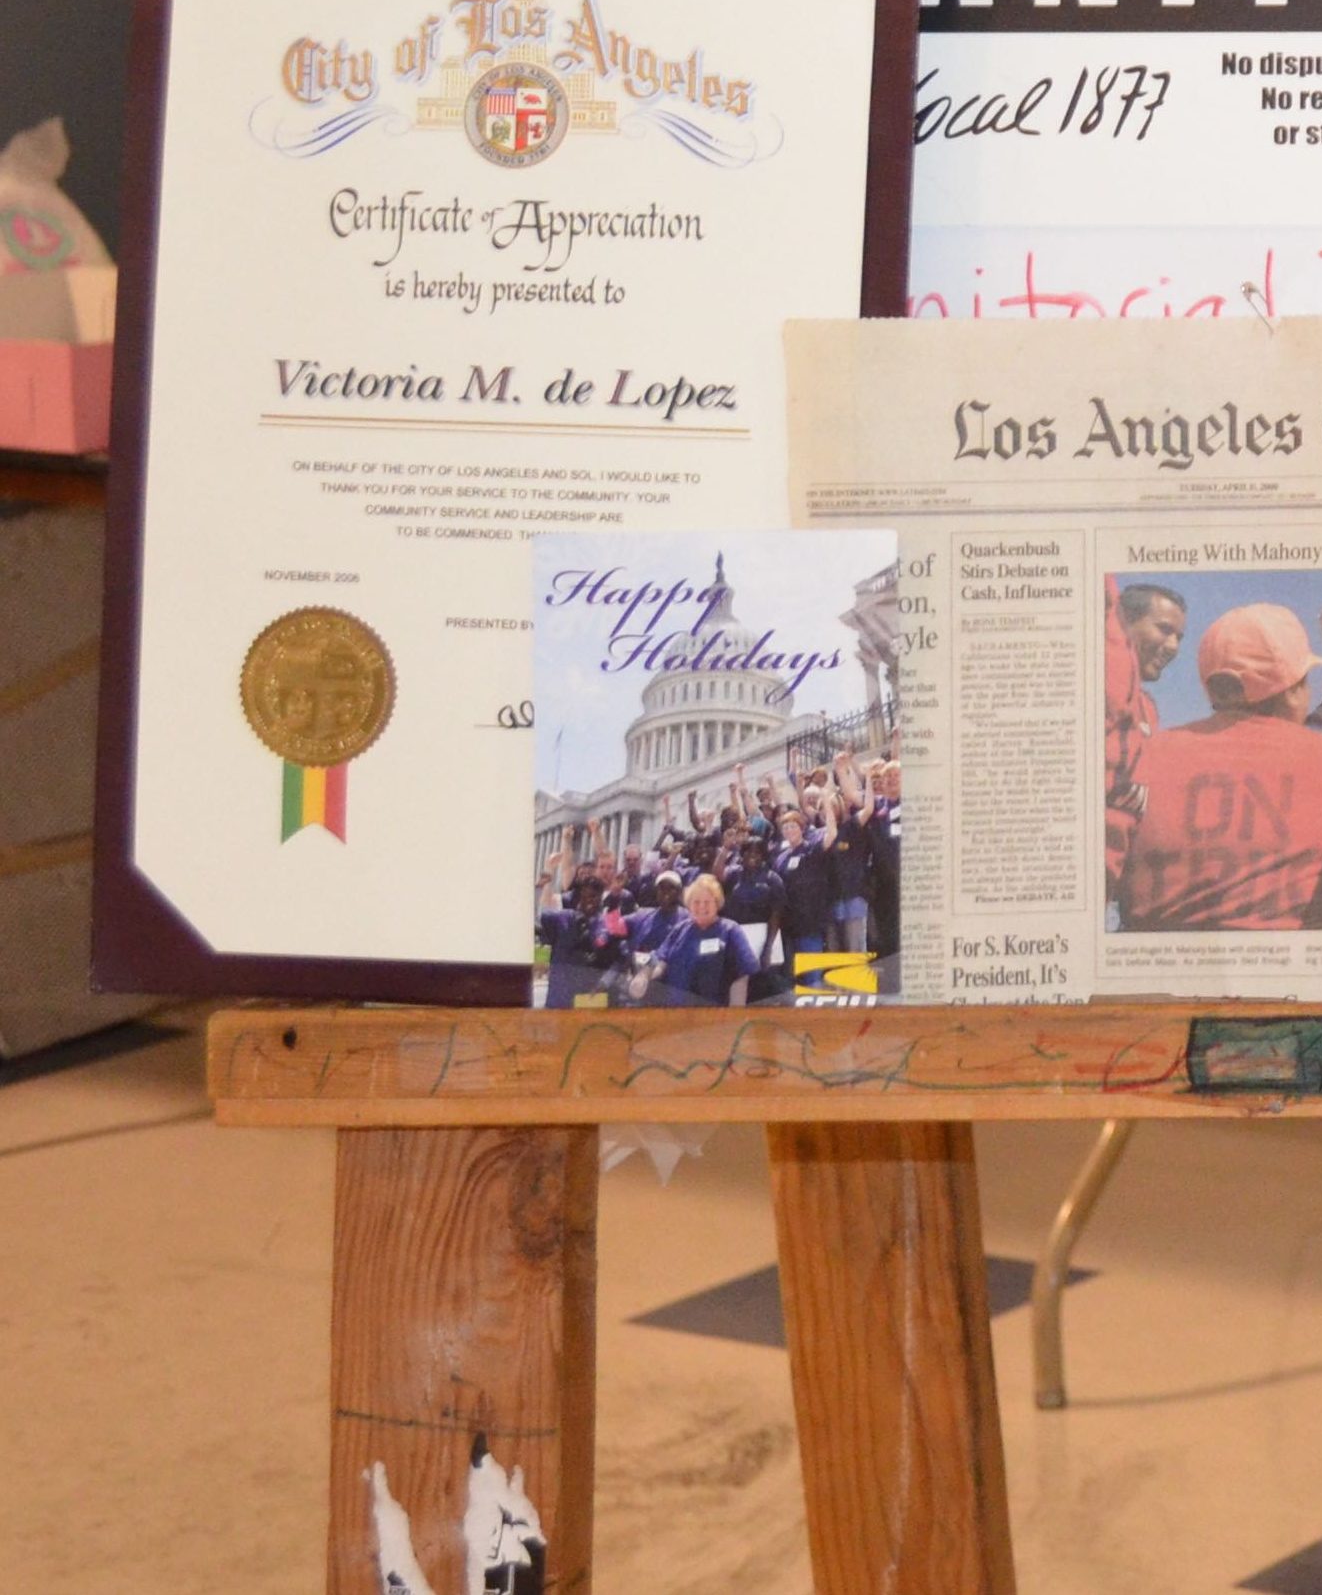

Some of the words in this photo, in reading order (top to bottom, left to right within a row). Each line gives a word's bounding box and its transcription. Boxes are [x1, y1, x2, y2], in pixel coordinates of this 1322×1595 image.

[281, 34, 376, 105] City
[392, 13, 440, 82] of
[1221, 52, 1253, 76] No
[914, 69, 1056, 145] ocal
[1261, 87, 1292, 110] No
[1273, 125, 1299, 145] or
[329, 187, 473, 267] Certificate
[481, 206, 505, 233] of
[491, 199, 705, 273] Appreciation
[385, 271, 405, 298] is
[413, 269, 481, 315] hereby
[490, 271, 596, 315] presented
[604, 277, 626, 304] to
[273, 359, 445, 401] Victoria
[458, 365, 522, 404] M.
[543, 367, 595, 405] de
[609, 369, 739, 422] Lopez
[953, 398, 1057, 461] Los
[1073, 396, 1303, 471] Angeles
[961, 541, 1060, 558] Quackenbush
[1128, 544, 1199, 566] Meeting
[1203, 542, 1246, 562] With
[1251, 542, 1322, 564] Mahony
[264, 570, 330, 585] NOVEMBER
[961, 563, 994, 579] Stirs
[998, 563, 1048, 579] Debate
[1051, 565, 1069, 577] on
[545, 567, 728, 638] Happy
[961, 584, 1001, 603] Cash,
[1005, 583, 1073, 601] Influence
[600, 629, 846, 705] Holidays
[952, 935, 981, 959] For
[985, 935, 999, 957] S.
[1005, 933, 1069, 956] Korea's
[952, 965, 1037, 988] President,
[1041, 962, 1067, 985] It's
